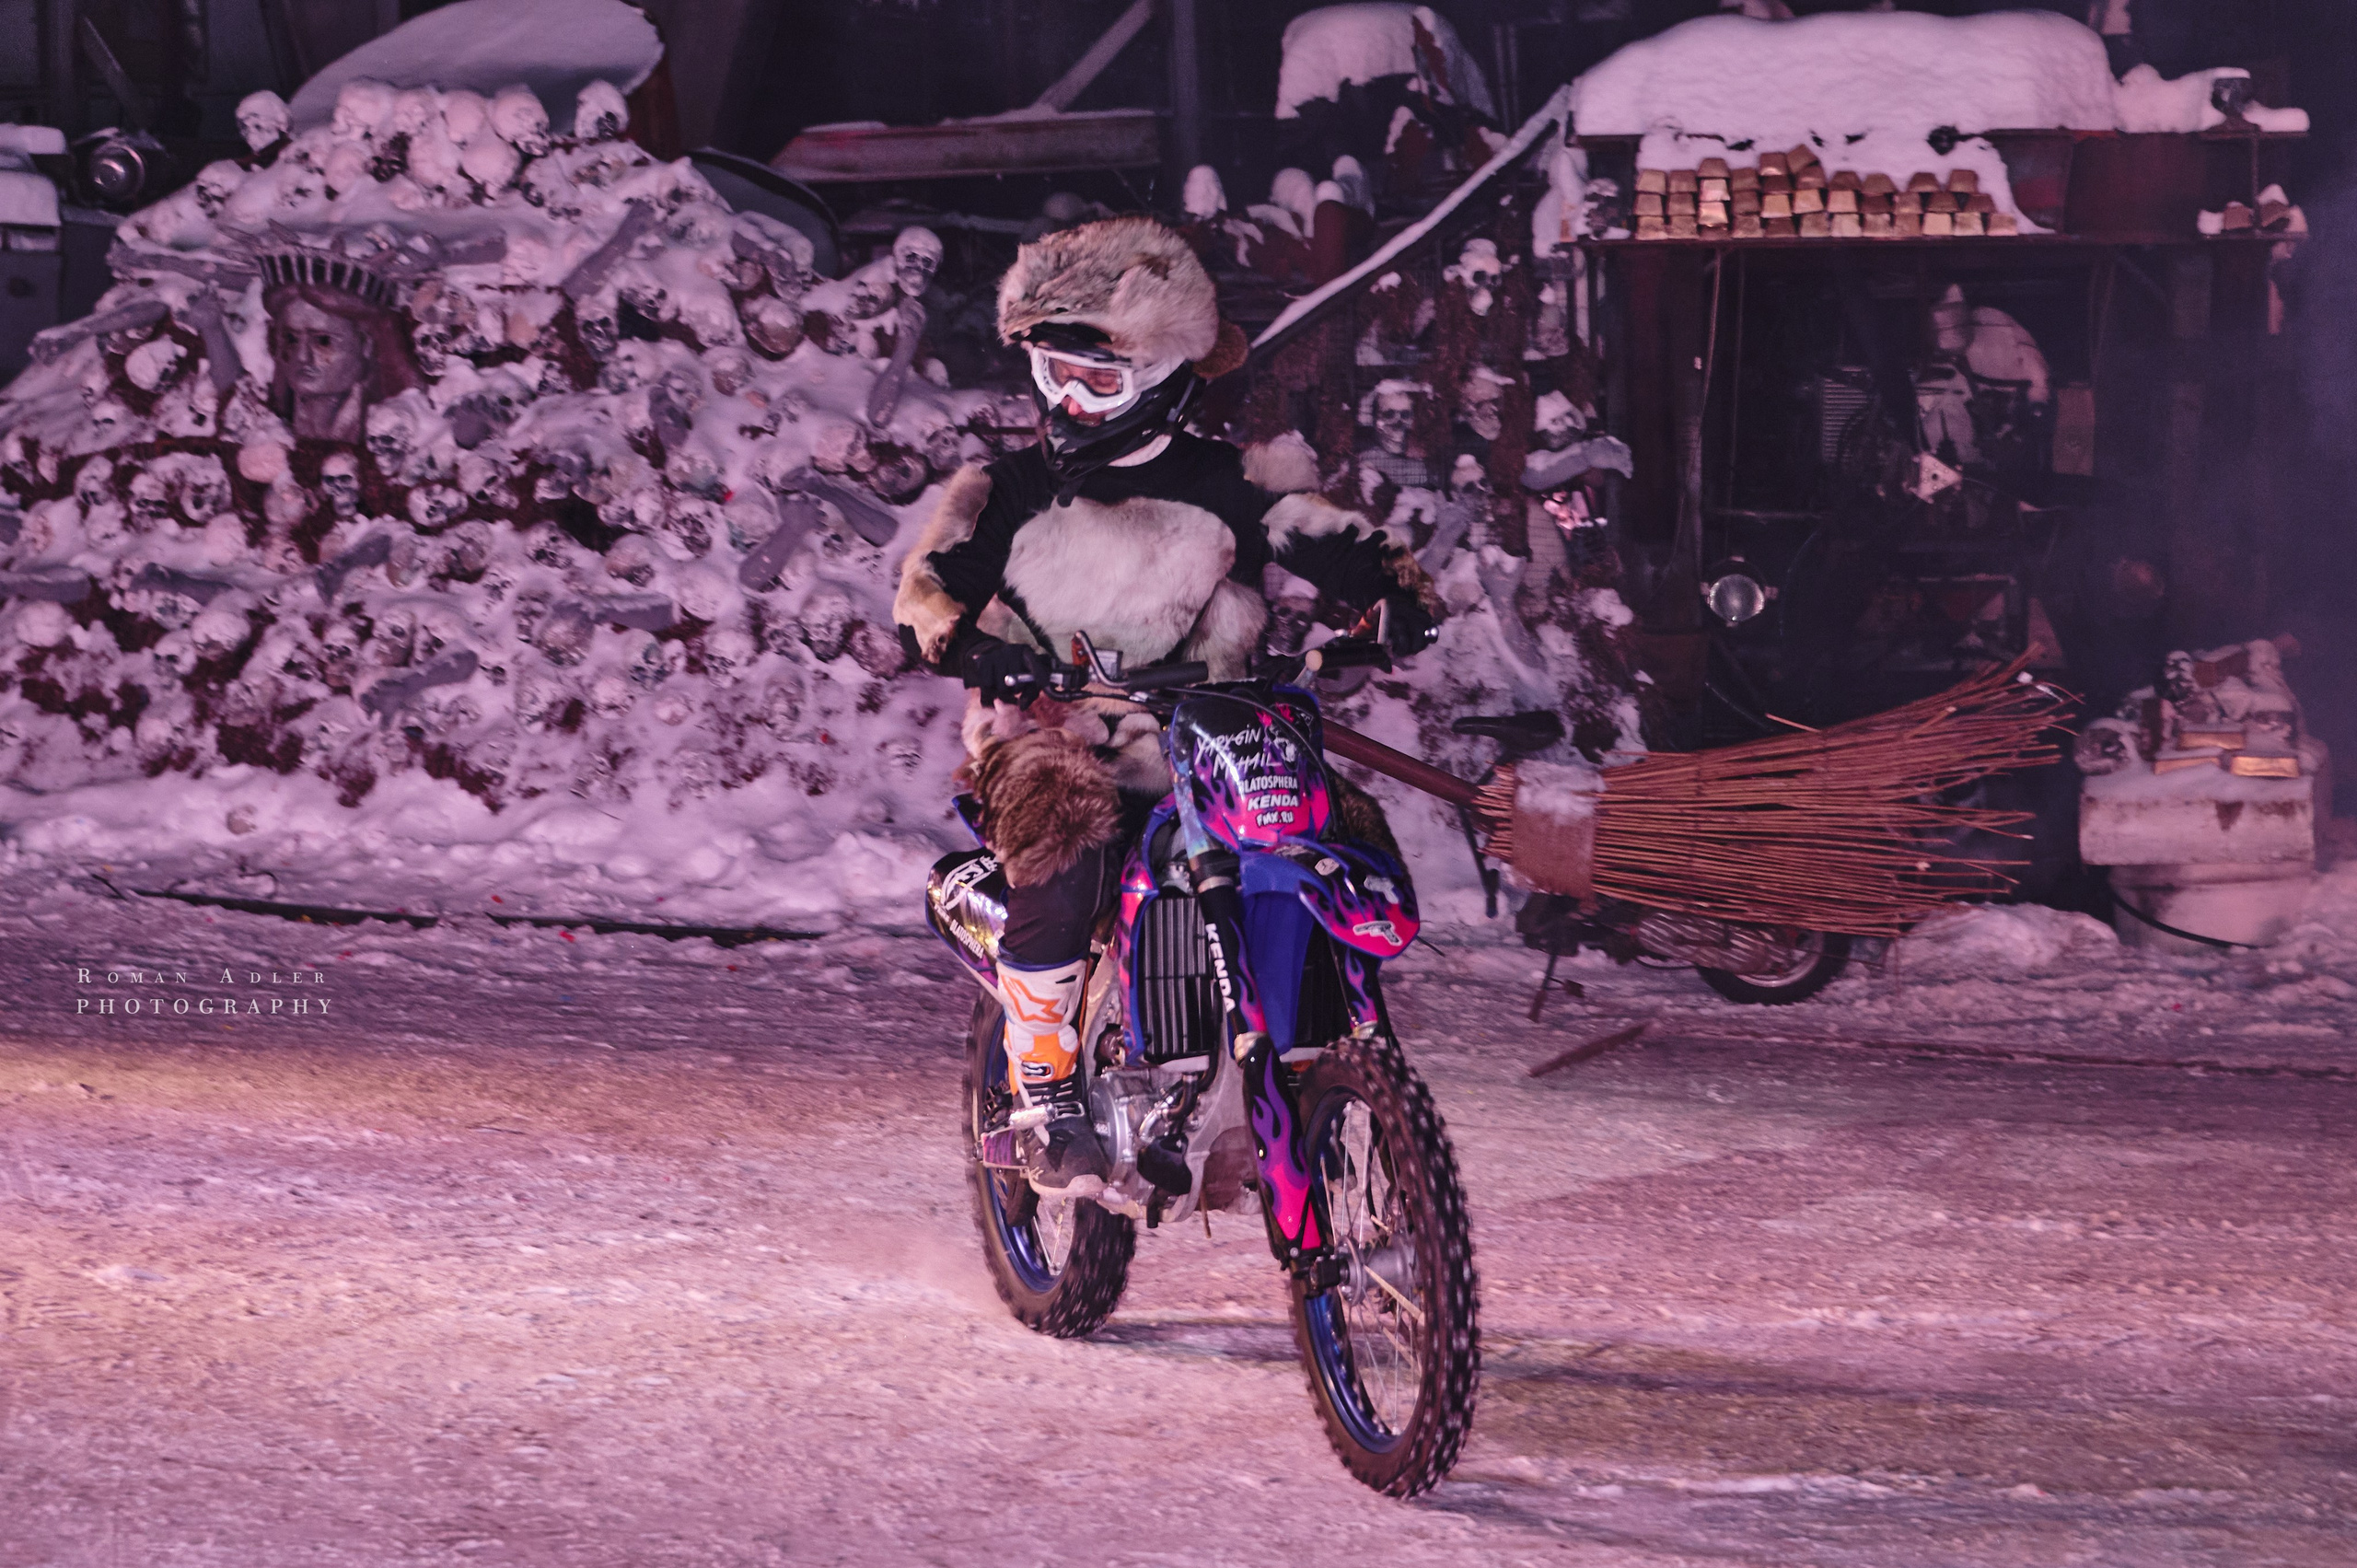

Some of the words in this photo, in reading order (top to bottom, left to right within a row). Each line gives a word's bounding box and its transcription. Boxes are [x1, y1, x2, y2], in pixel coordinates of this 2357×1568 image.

[1248, 794, 1299, 811] KENDA
[1256, 811, 1295, 827] FMX.RU
[1205, 923, 1236, 1013] KENDA
